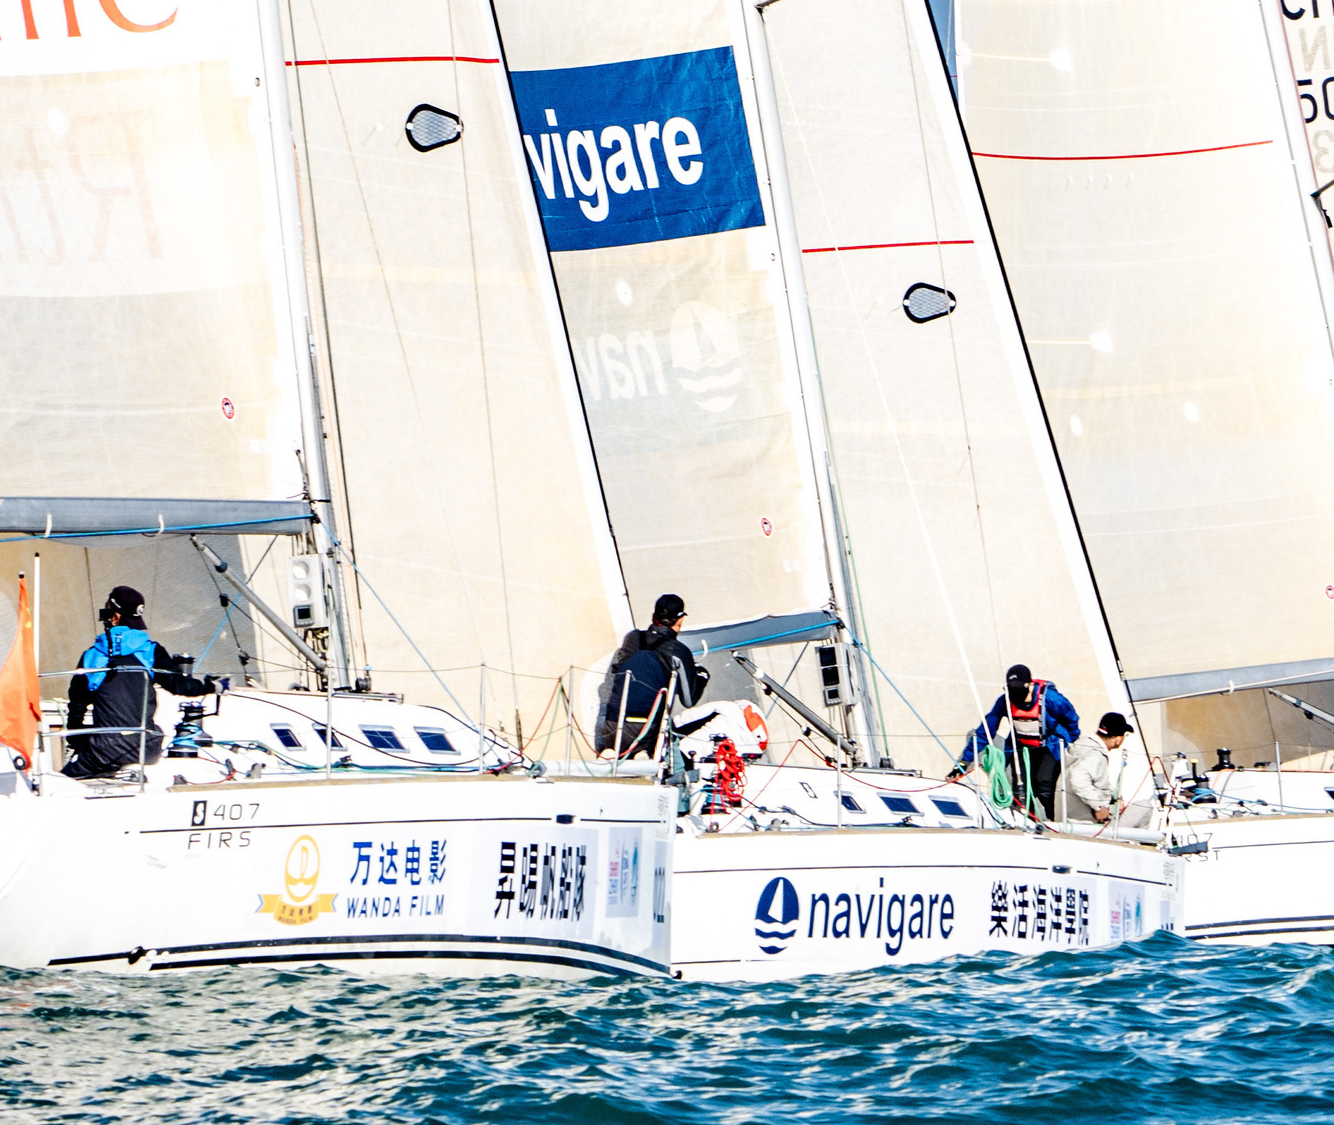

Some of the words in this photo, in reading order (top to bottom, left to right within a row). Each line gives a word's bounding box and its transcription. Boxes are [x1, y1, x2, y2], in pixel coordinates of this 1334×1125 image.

[523, 108, 704, 223] vigare
[213, 803, 260, 821] 407
[187, 830, 252, 849] FIRS
[350, 839, 447, 886] 万达电影
[347, 896, 401, 918] WANDA
[409, 894, 445, 917] FILM
[807, 877, 954, 956] navigare
